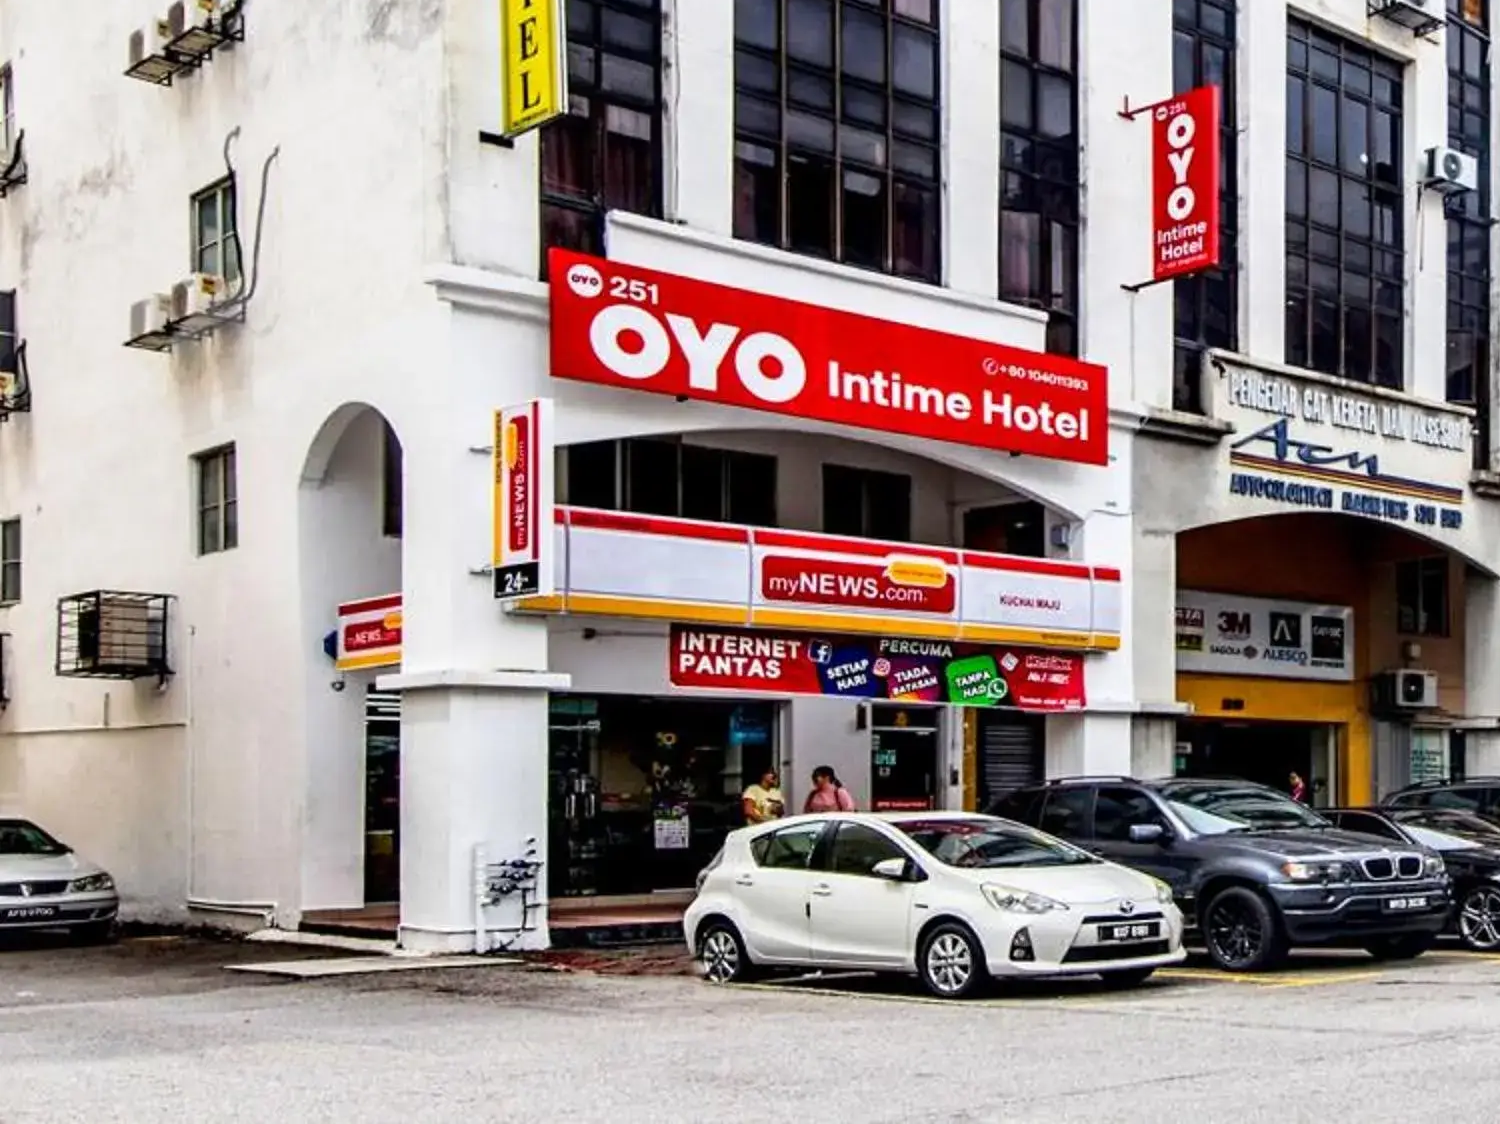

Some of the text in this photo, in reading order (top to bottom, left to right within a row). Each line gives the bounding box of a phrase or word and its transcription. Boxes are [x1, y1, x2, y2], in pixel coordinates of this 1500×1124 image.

[1167, 113, 1196, 221] OYO
[1157, 221, 1208, 245] Intime
[1161, 236, 1204, 261] Hotel
[609, 276, 659, 305] 251
[589, 303, 807, 403] OYO
[828, 360, 1089, 441] Intime Hotel
[503, 571, 523, 594] 24
[1217, 610, 1251, 635] 3M
[680, 631, 803, 659] INTERNET
[880, 639, 953, 657] PERCUMA
[679, 654, 782, 679] PANTAS
[827, 659, 869, 679] SETIAP
[893, 665, 931, 683] TIADA
[836, 674, 867, 691] HARI
